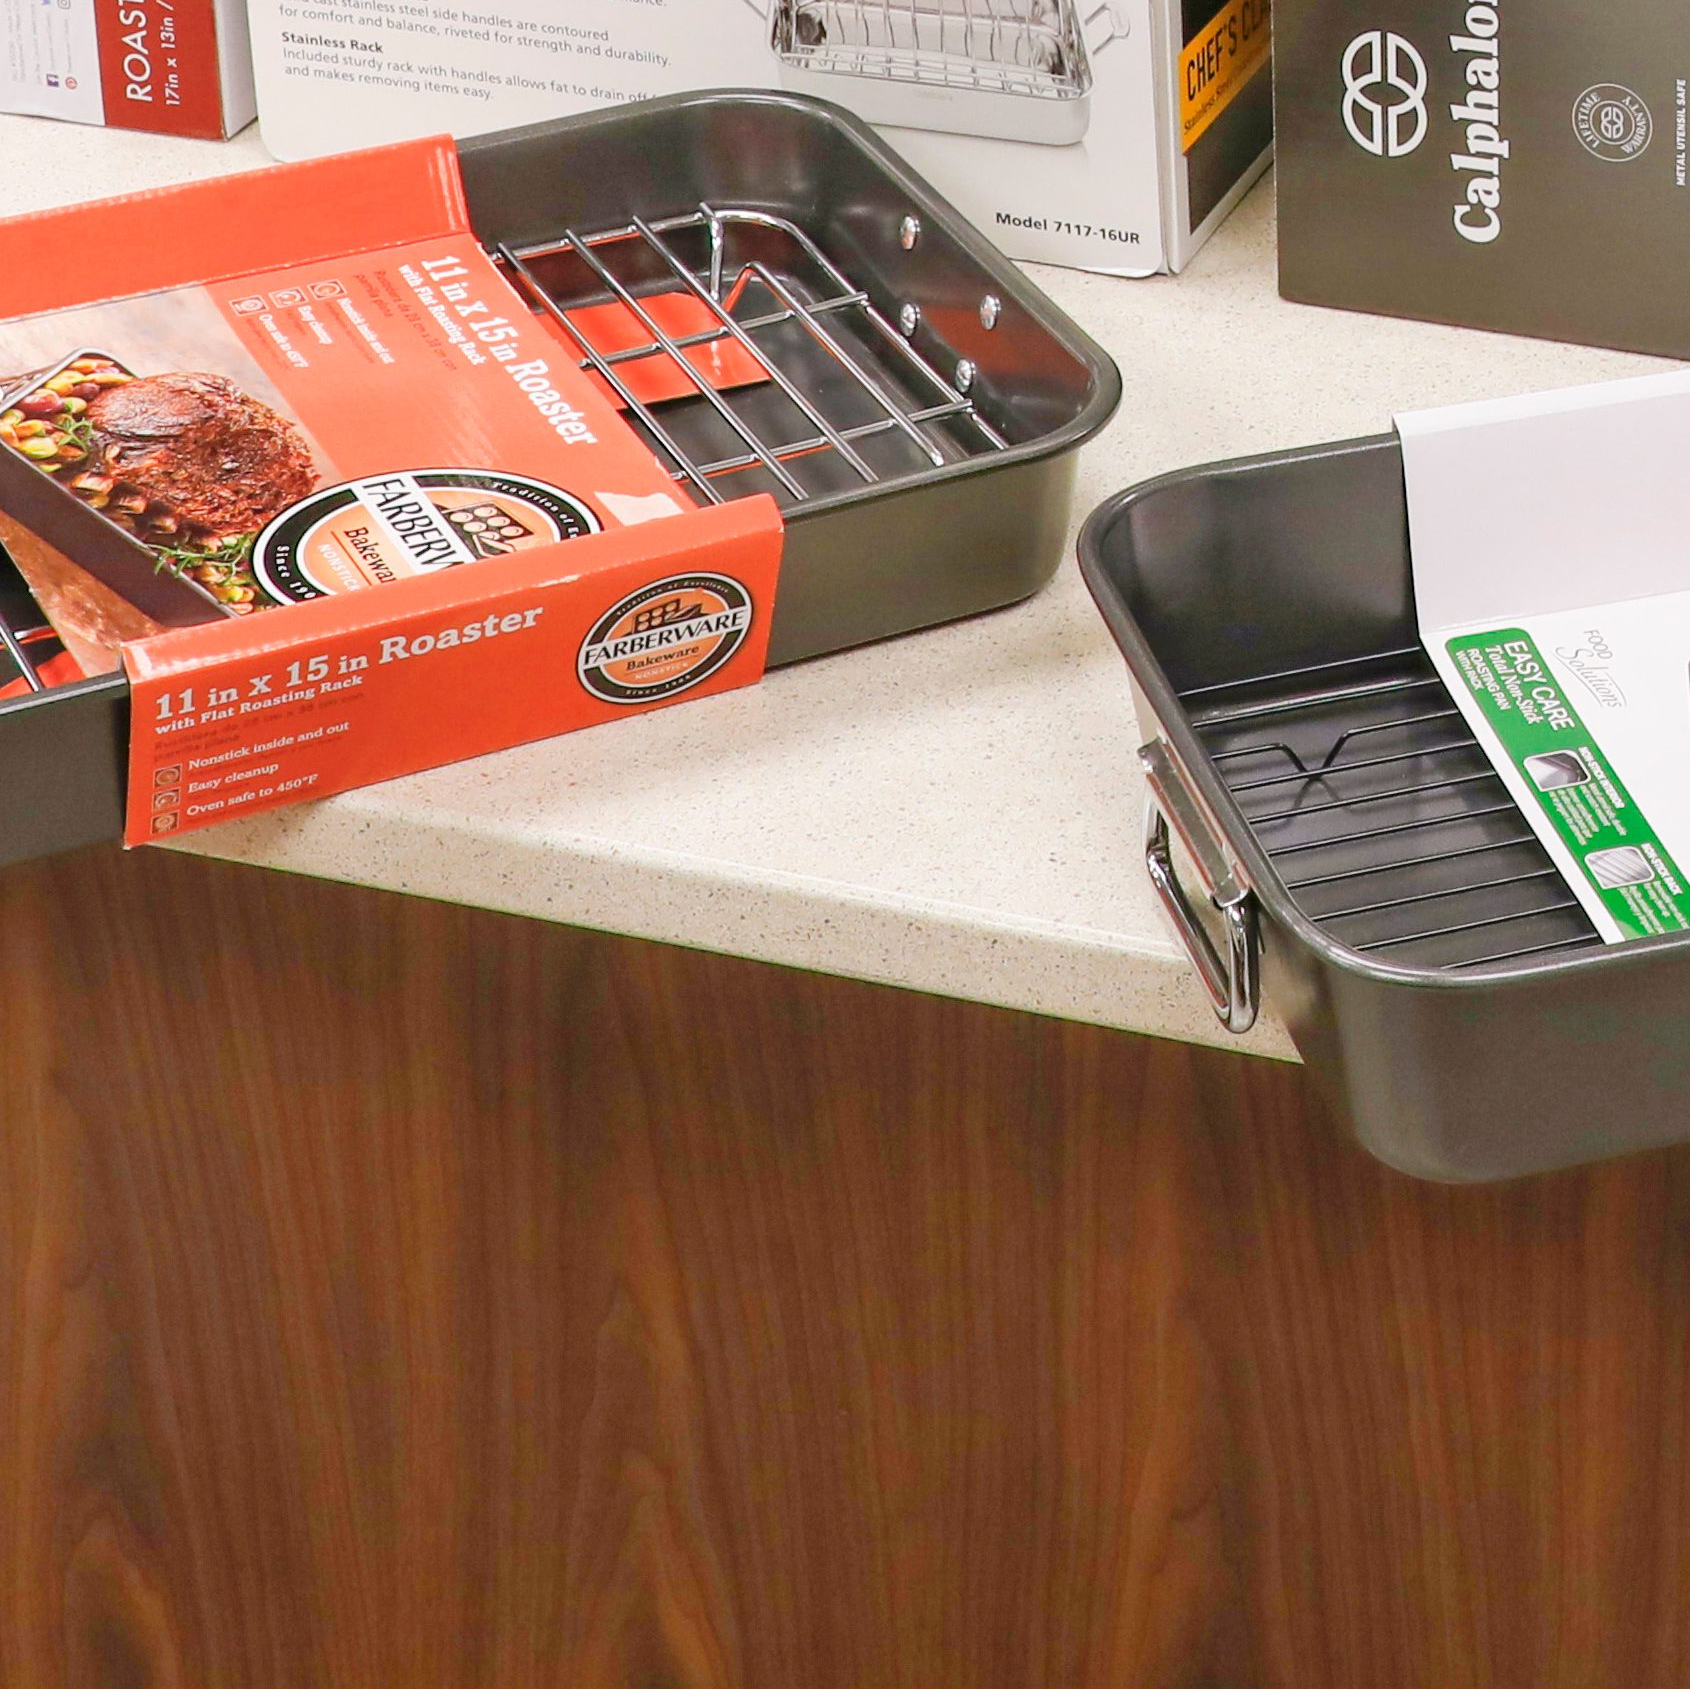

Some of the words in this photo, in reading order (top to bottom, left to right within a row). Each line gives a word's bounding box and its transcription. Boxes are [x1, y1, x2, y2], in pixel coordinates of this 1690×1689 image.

[160, 17, 176, 49] 13in
[281, 31, 346, 49] Stainless
[350, 39, 384, 54] Rack
[166, 57, 178, 68] x
[1186, 17, 1237, 101] CHEF'S
[165, 73, 181, 105] 17in
[1676, 78, 1687, 106] SAFE
[1578, 91, 1601, 149] LIFETIME
[1621, 95, 1647, 154] WARRANTY
[1676, 108, 1686, 150] UTENSIL
[1676, 152, 1686, 186] METAL
[995, 212, 1048, 232] Model
[1052, 218, 1140, 244] 7117-16UR
[421, 255, 469, 282] 11
[440, 282, 469, 302] in
[398, 264, 424, 287] with
[413, 286, 438, 306] Flat
[427, 304, 467, 344] Roasting
[458, 341, 488, 366] Rack
[469, 317, 519, 342] 15
[488, 343, 518, 362] in
[504, 358, 598, 445] Roaster
[362, 478, 465, 570] FARBERW
[583, 610, 745, 665] FARBERWARE
[1583, 629, 1614, 660] FOOD
[155, 688, 196, 721] 11
[208, 685, 238, 707] in
[286, 655, 328, 688] 15
[338, 653, 369, 675] in
[379, 606, 543, 665] Roaster
[626, 645, 700, 671] Bakeware
[1456, 650, 1473, 672] WITH
[1466, 670, 1484, 690] RACK
[1555, 646, 1624, 708] Solutions
[1467, 648, 1501, 693] ROASTING
[1491, 691, 1511, 710] PAN
[1485, 644, 1515, 674] Total
[1501, 675, 1544, 724] Non-Stick
[1503, 640, 1548, 682] EASY
[1531, 686, 1575, 731] CARE
[155, 714, 195, 735] with
[200, 706, 235, 724] Flat
[240, 687, 316, 715] Roasting
[320, 674, 363, 695] Rack
[189, 746, 250, 771] Nonstick
[253, 737, 294, 756] inside
[297, 728, 323, 745] and
[327, 722, 350, 738] out
[188, 776, 221, 794] Easy
[224, 763, 279, 786] cleanup
[187, 799, 224, 816] Oven
[228, 791, 256, 808] safe
[259, 785, 274, 798] to
